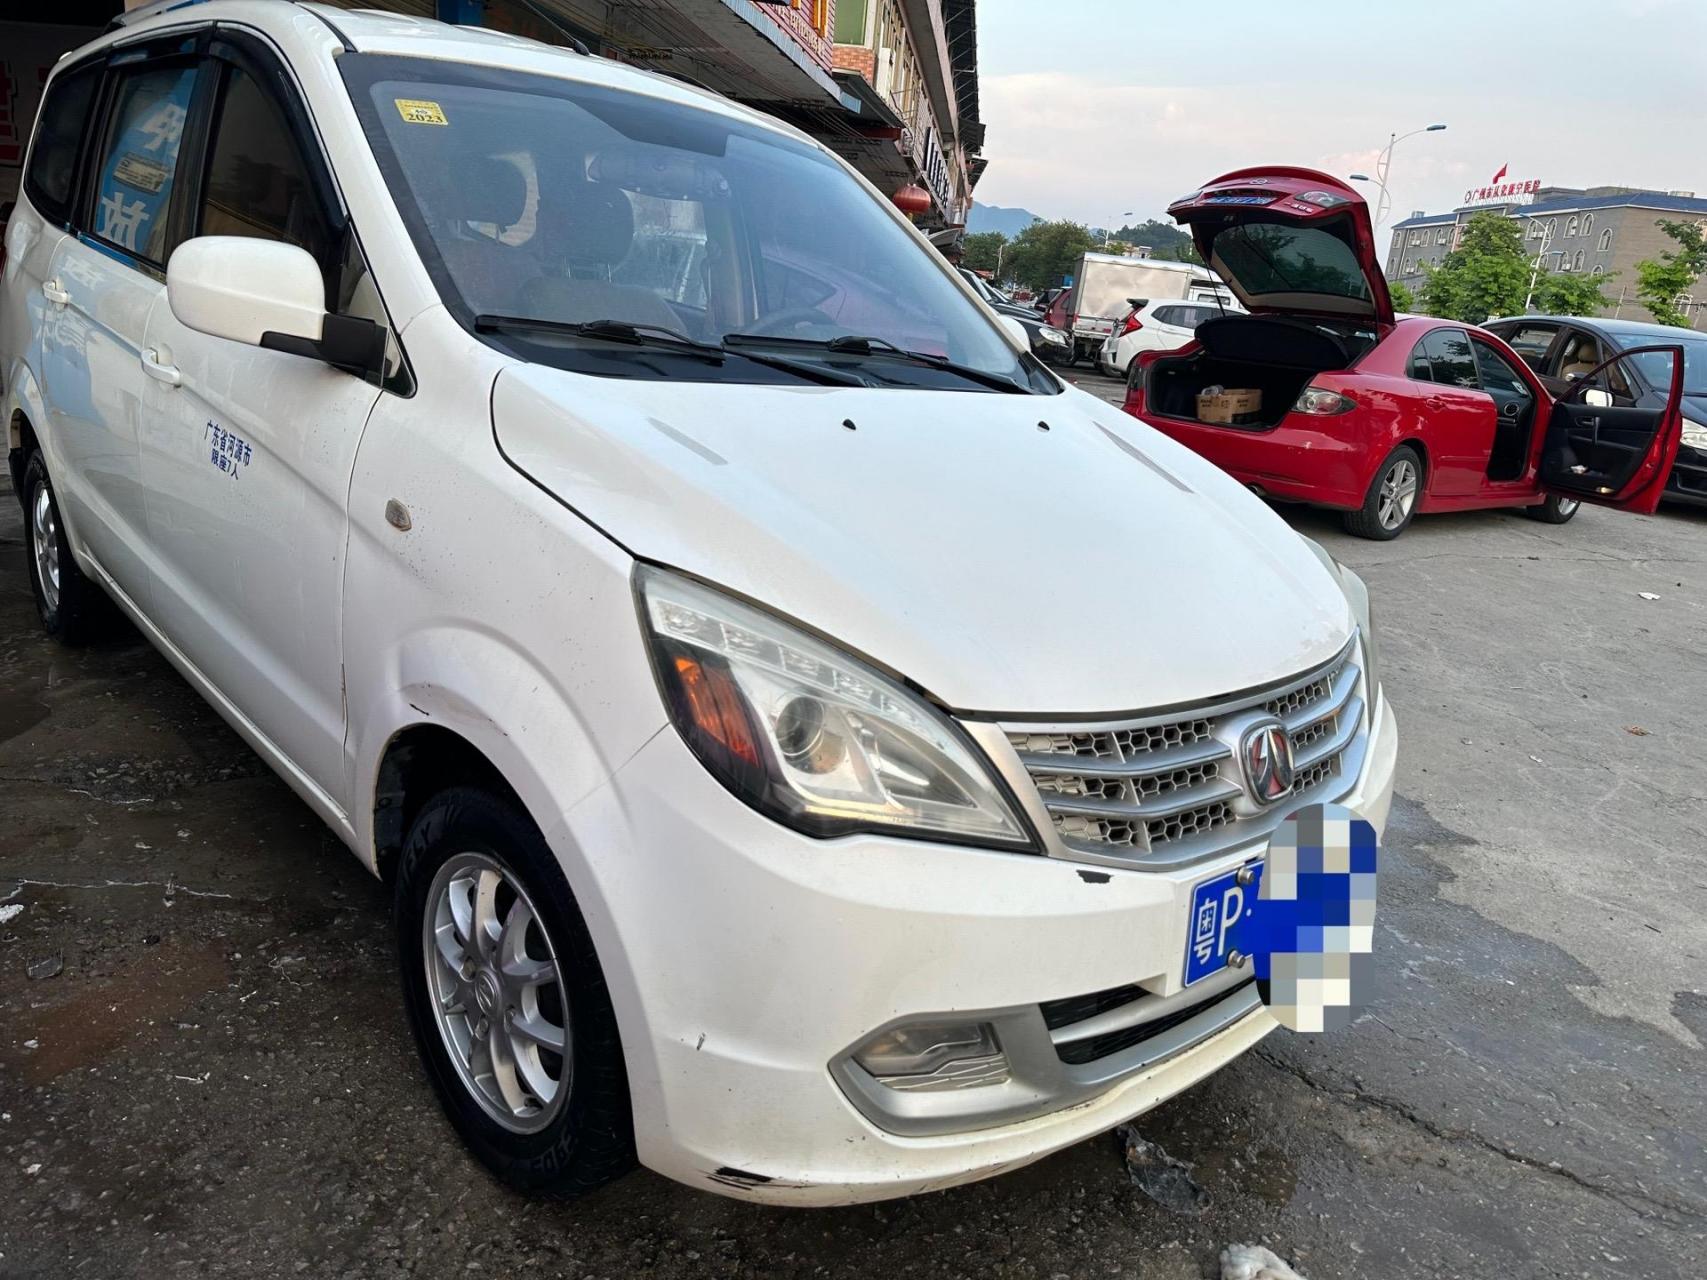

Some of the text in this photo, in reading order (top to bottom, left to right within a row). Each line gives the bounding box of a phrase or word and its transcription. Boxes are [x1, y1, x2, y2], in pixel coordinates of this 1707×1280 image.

[407, 113, 443, 123] 2023
[204, 420, 252, 466] 广东省河源市
[211, 449, 239, 480] 限座7人
